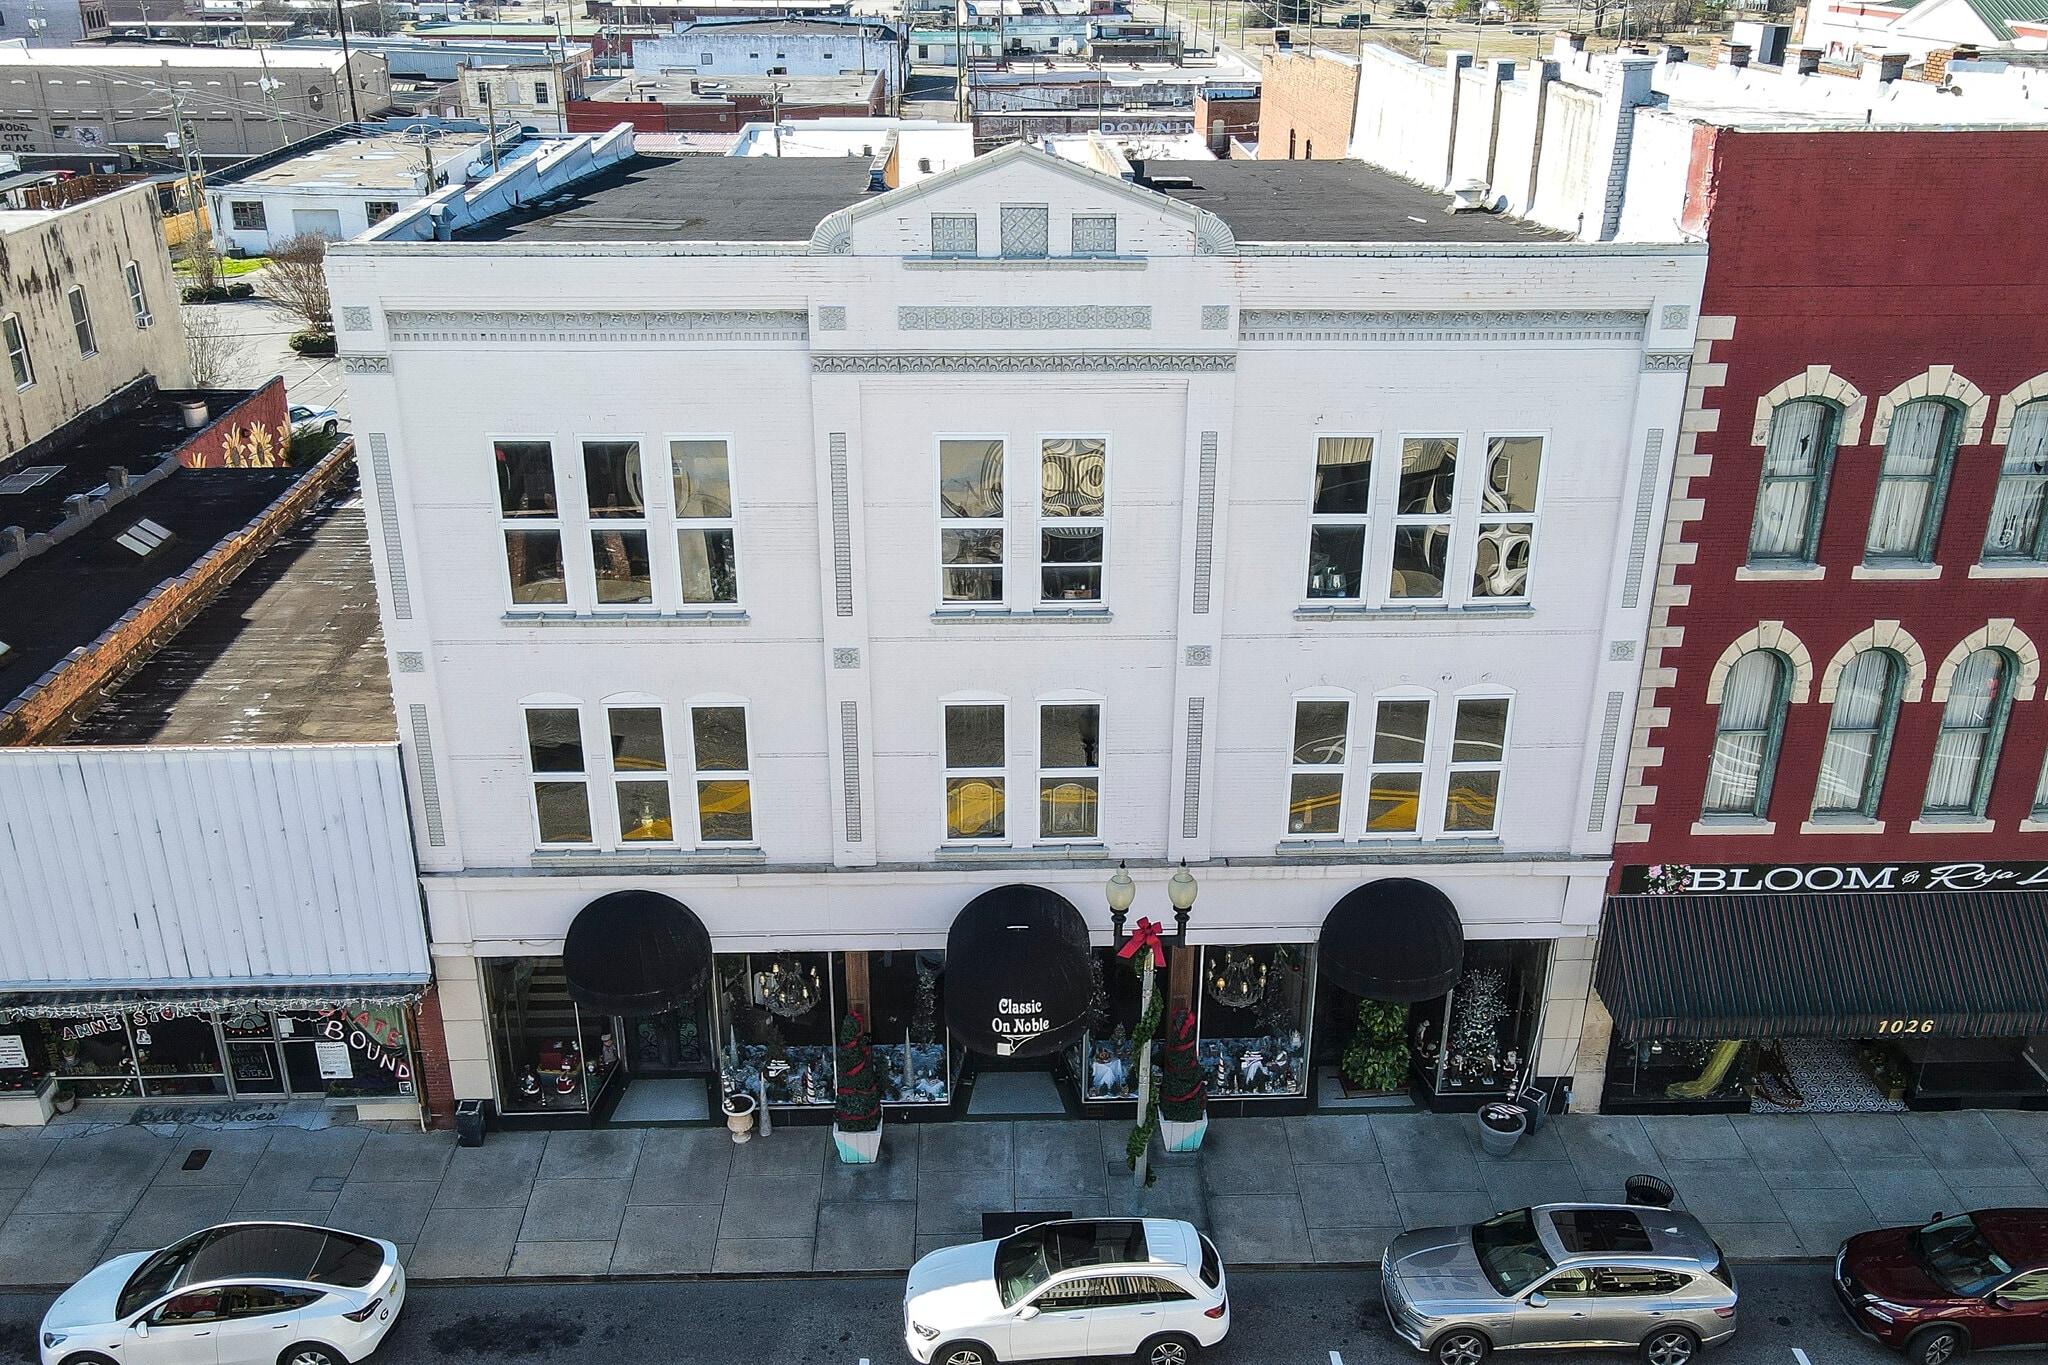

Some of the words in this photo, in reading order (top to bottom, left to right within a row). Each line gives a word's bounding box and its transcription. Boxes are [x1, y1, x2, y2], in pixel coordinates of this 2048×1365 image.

[4, 133, 28, 142] CITY
[1, 144, 36, 152] GLASS
[1684, 867, 1899, 891] BLOOM
[1925, 863, 2021, 890] Rosa
[998, 998, 1043, 1014] Classic
[991, 1017, 1011, 1033] On
[1013, 1017, 1050, 1033] Noble
[1878, 1019, 1935, 1034] 1026
[323, 1020, 410, 1078] BOUND
[212, 1108, 280, 1122] Shoes
